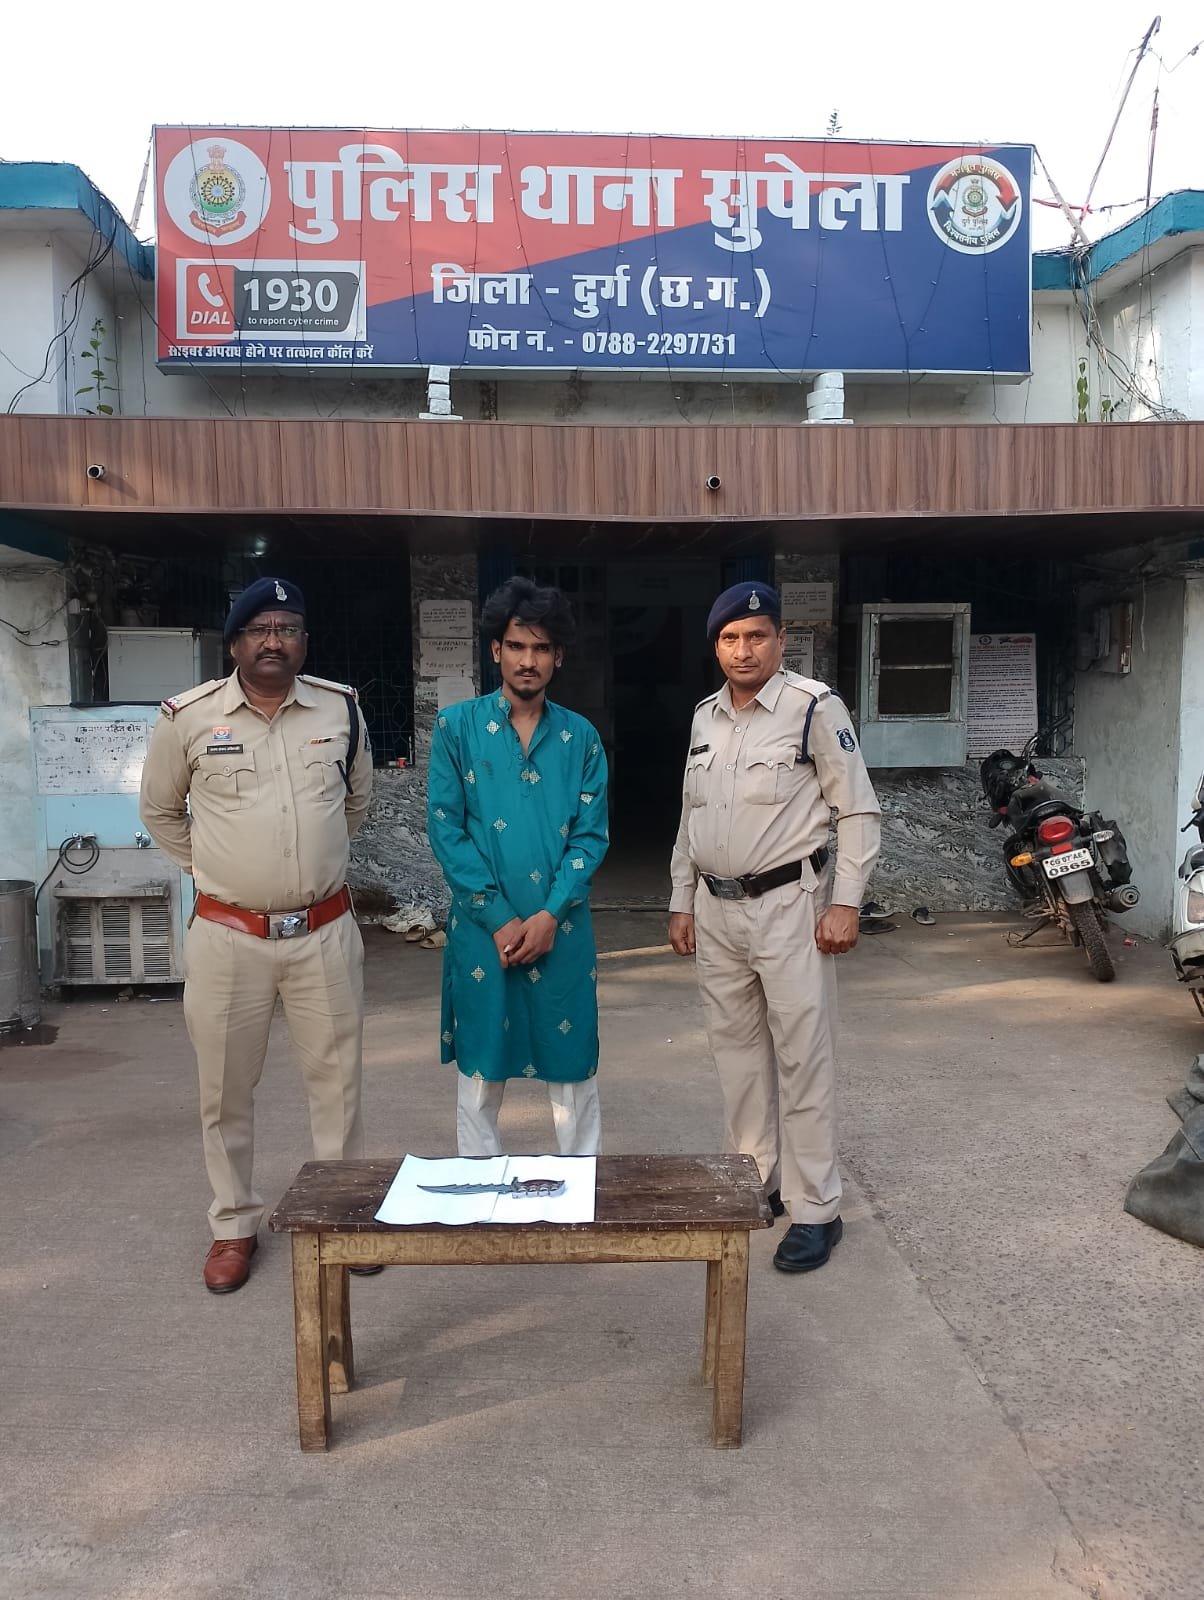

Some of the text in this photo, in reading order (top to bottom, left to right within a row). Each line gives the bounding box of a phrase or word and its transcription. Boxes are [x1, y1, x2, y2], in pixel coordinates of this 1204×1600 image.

[284, 144, 911, 252] पुलिस थाना सुपेला
[244, 278, 339, 313] 1930
[431, 263, 533, 305] जिला
[573, 265, 631, 318] दुर्ग
[640, 266, 772, 318] (छ.ग.)
[191, 311, 231, 325] DIAL
[248, 317, 339, 327] to report cyber crime
[468, 324, 520, 351] फोन
[582, 332, 736, 355] 0788-2297731
[168, 343, 374, 359] साइबर अपराध होने पर तत्काल कॉल करें
[1049, 859, 1091, 876] 0865
[1050, 858, 1061, 866] CG
[1073, 852, 1084, 860] AE
